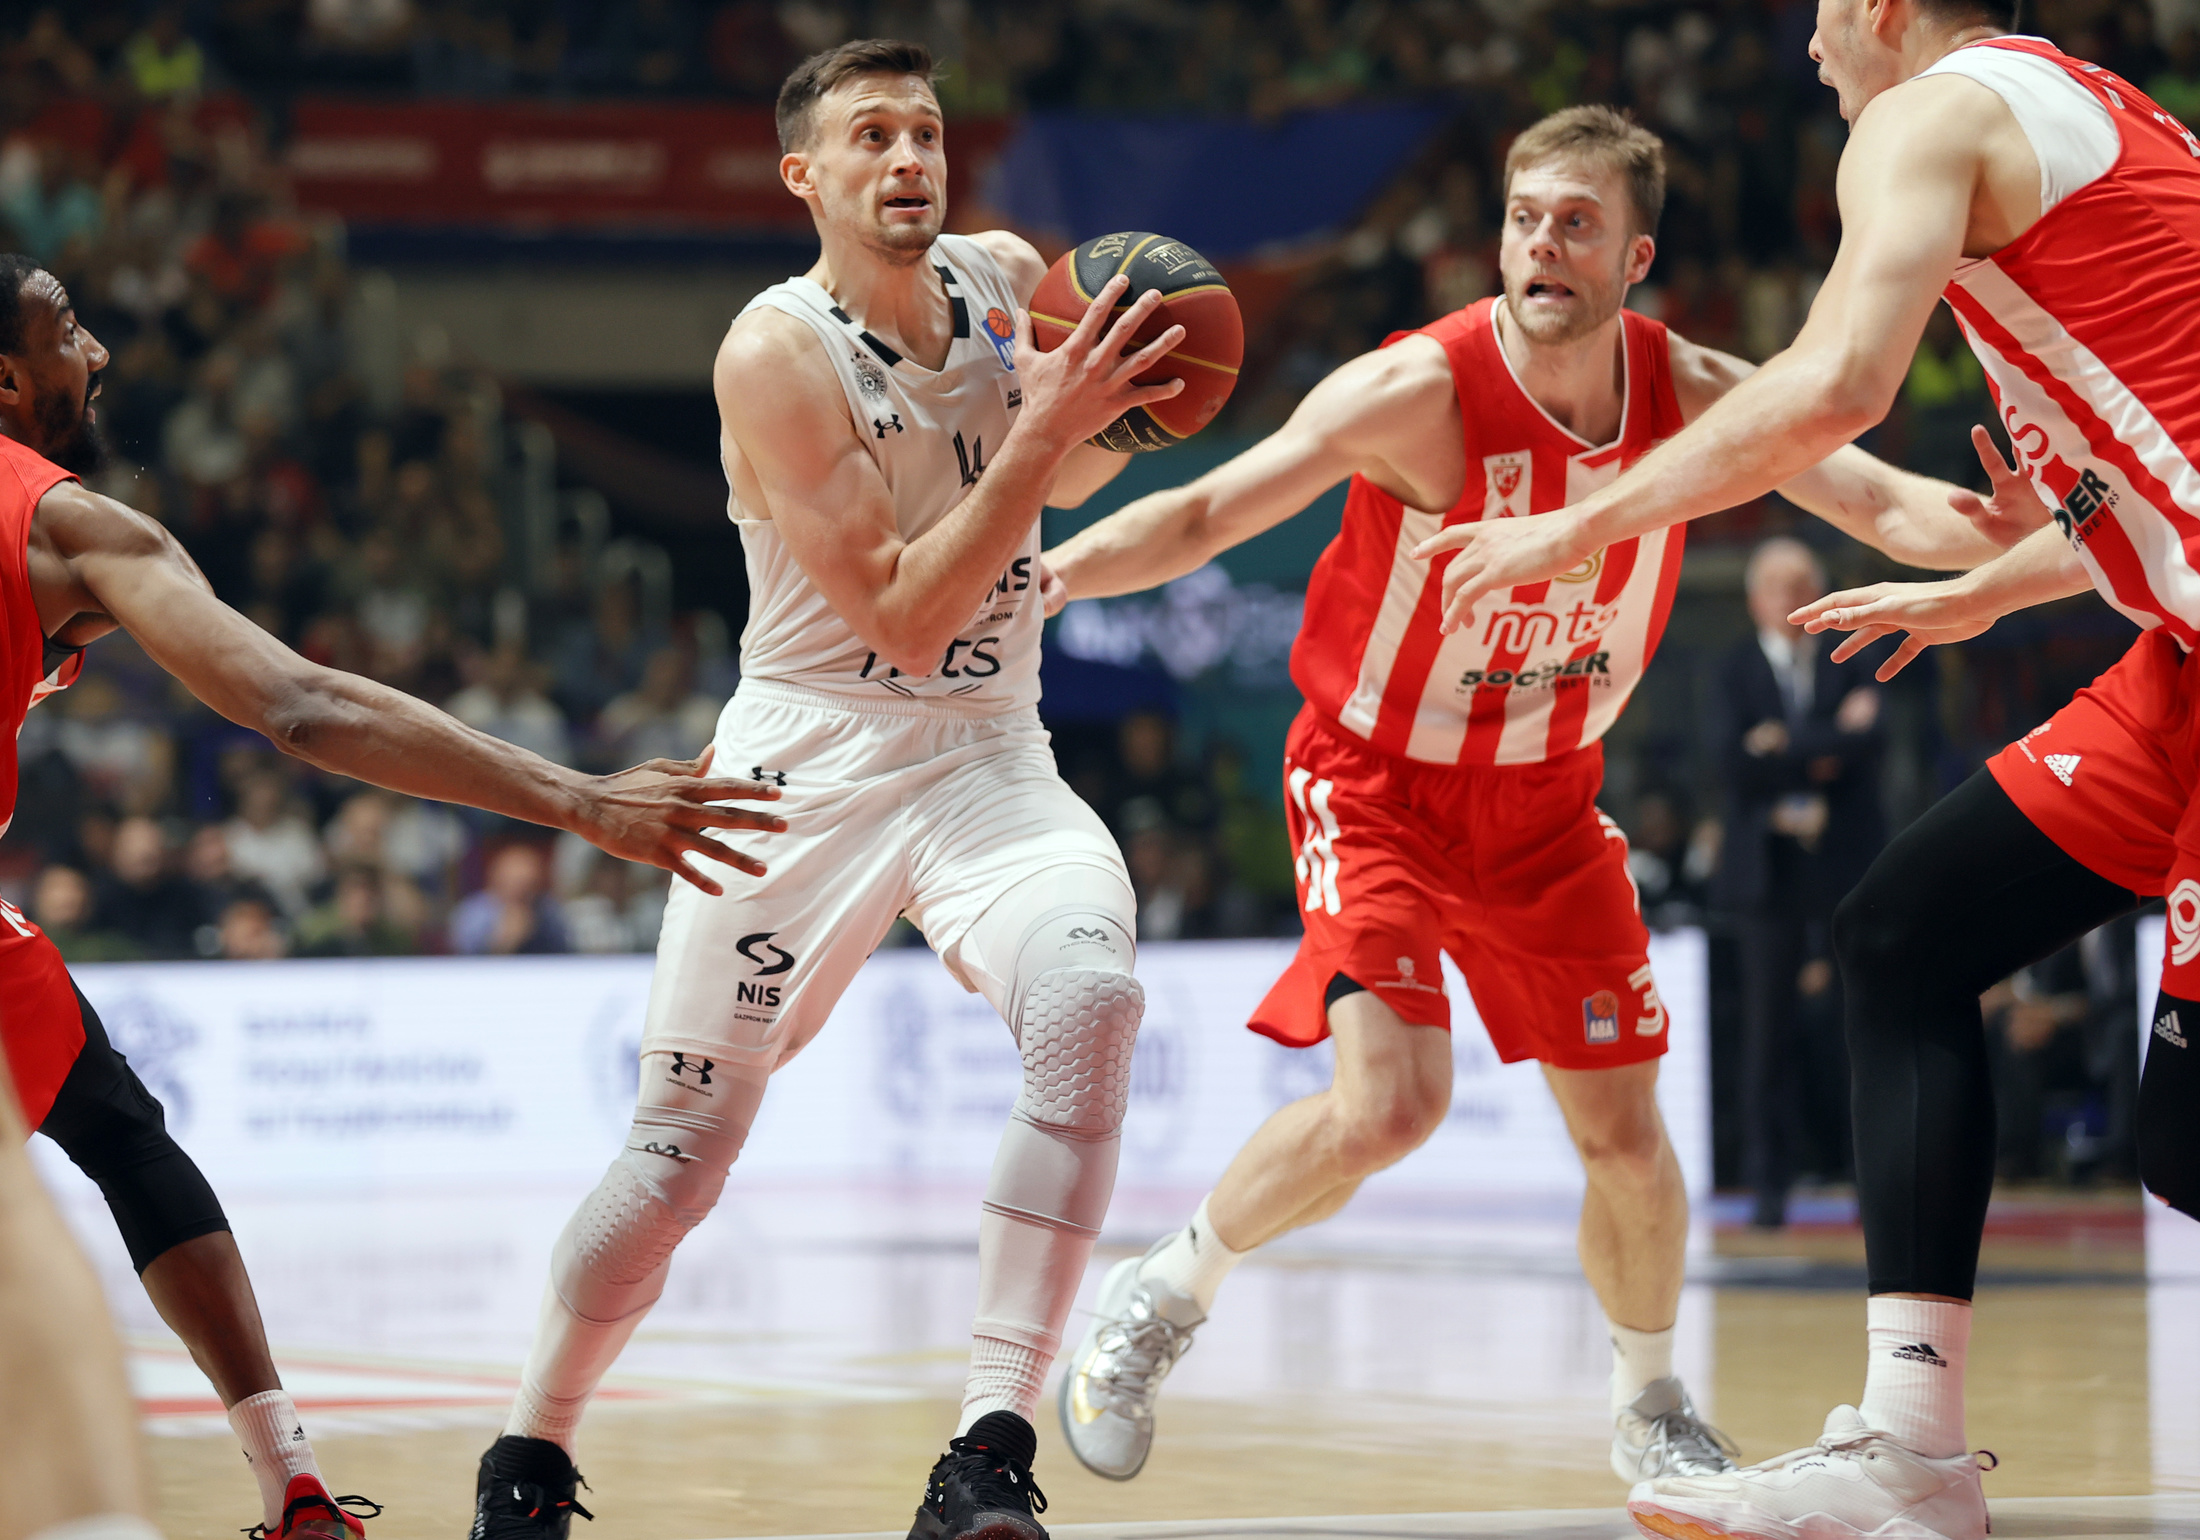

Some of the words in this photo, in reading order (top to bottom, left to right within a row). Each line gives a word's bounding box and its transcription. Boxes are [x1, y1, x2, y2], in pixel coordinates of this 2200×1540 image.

[737, 981, 781, 1007] NIS
[1626, 962, 1665, 1037] 3
[1589, 1019, 1615, 1039] ABA
[2153, 1022, 2188, 1049] adidas
[1892, 1350, 1948, 1368] adidas
